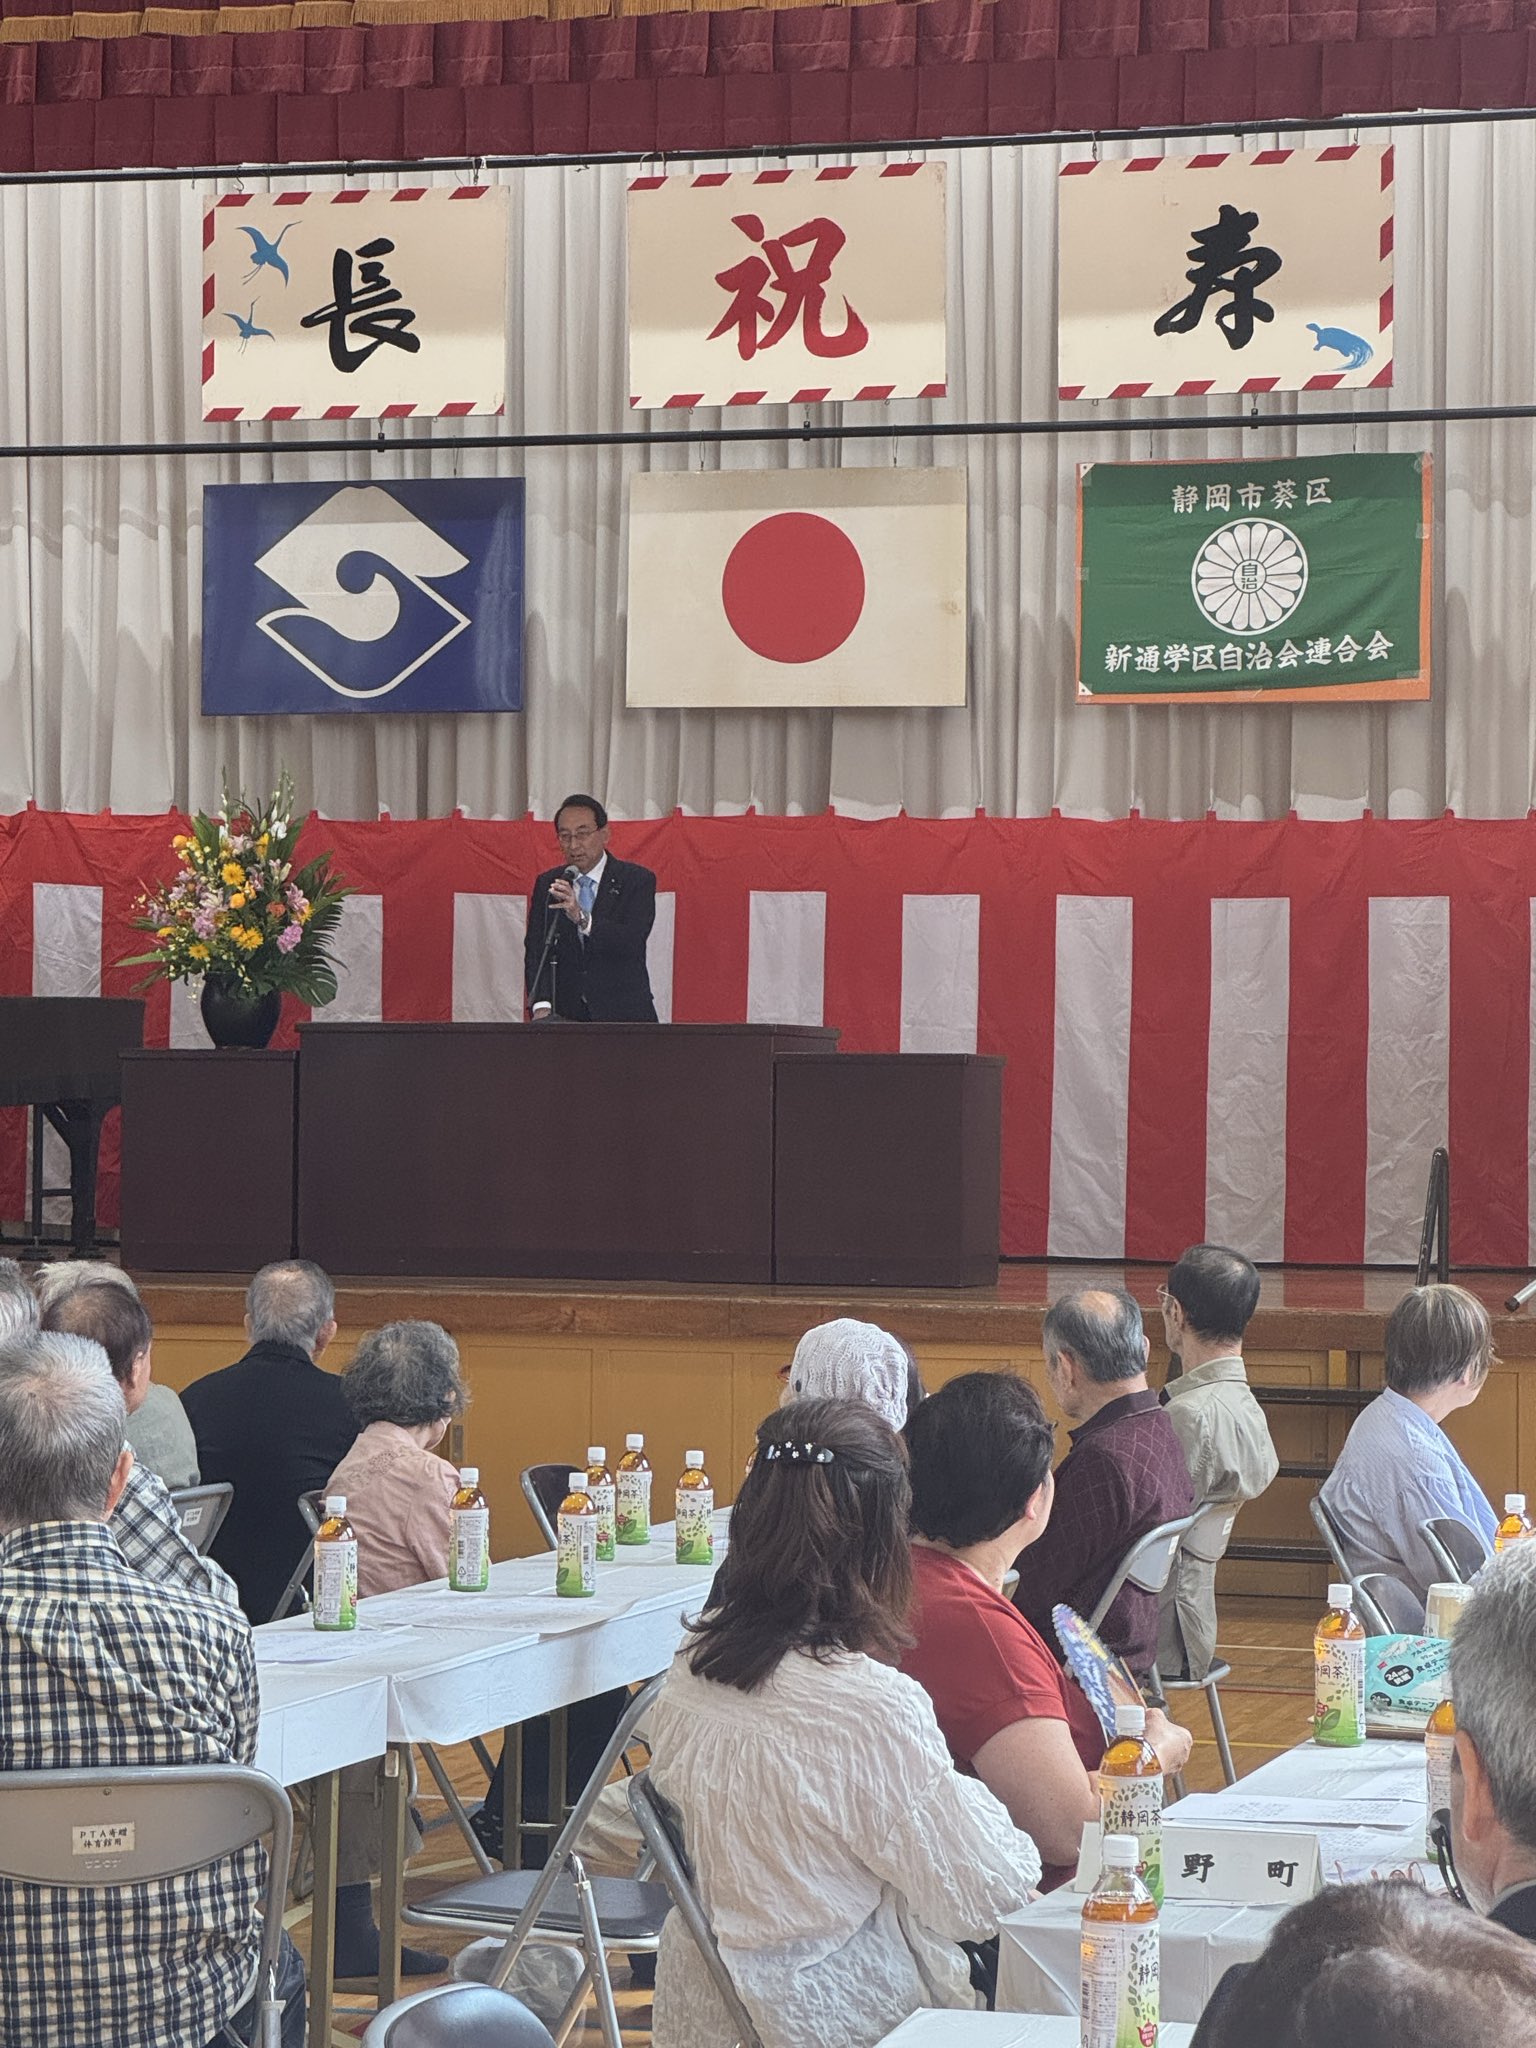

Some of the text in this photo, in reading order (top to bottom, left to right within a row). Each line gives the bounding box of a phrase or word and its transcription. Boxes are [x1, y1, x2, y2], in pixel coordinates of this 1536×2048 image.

[705, 213, 870, 362] 祝
[1153, 204, 1283, 351] 寿
[300, 237, 421, 374] 長
[1171, 477, 1333, 514] 静岡市葵区
[1241, 562, 1258, 590] 自治
[1104, 630, 1395, 674] 新通学区自治会連合会
[1315, 1663, 1345, 1680] 岡茶
[1120, 1808, 1162, 1829] 静岡茶
